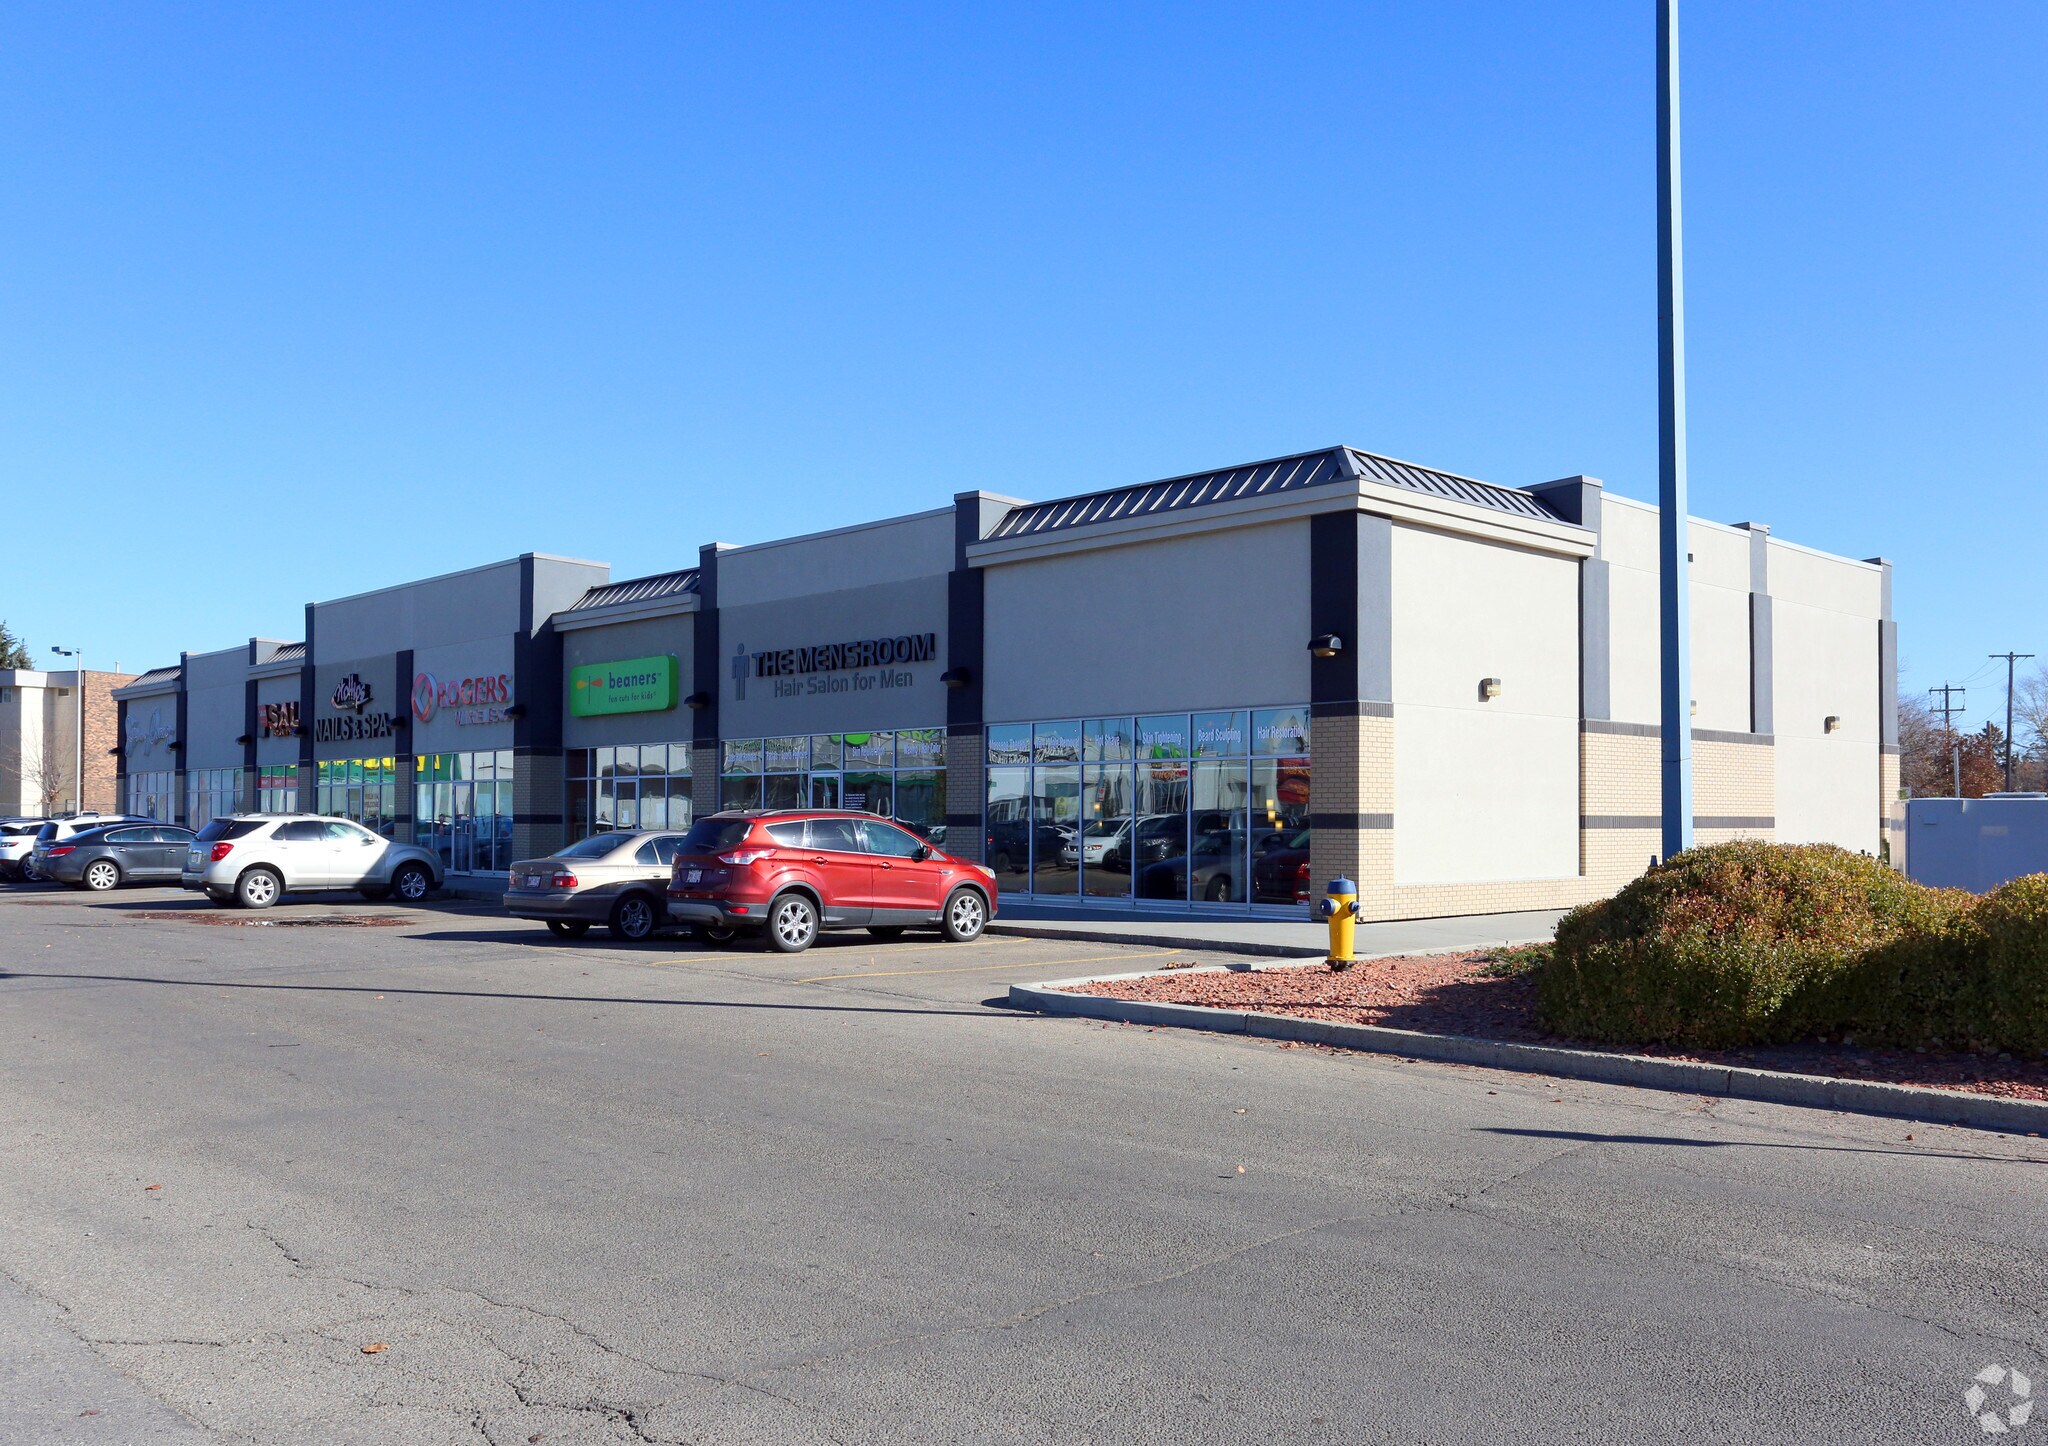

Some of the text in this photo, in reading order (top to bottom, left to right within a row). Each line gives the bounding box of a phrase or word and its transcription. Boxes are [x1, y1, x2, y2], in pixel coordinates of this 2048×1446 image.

[752, 648, 795, 677] THE
[608, 672, 657, 689] beaners
[774, 669, 913, 698] Hair Salon for Men
[437, 674, 509, 708] ROGERS
[608, 694, 618, 704] fun
[619, 693, 630, 703] cuts
[631, 692, 640, 702] for
[315, 713, 390, 742] NAILS & SPA
[1198, 727, 1242, 743] Beard Sculpting
[1257, 724, 1306, 740] Hair Restoration
[1142, 730, 1182, 746] Skin Tightening
